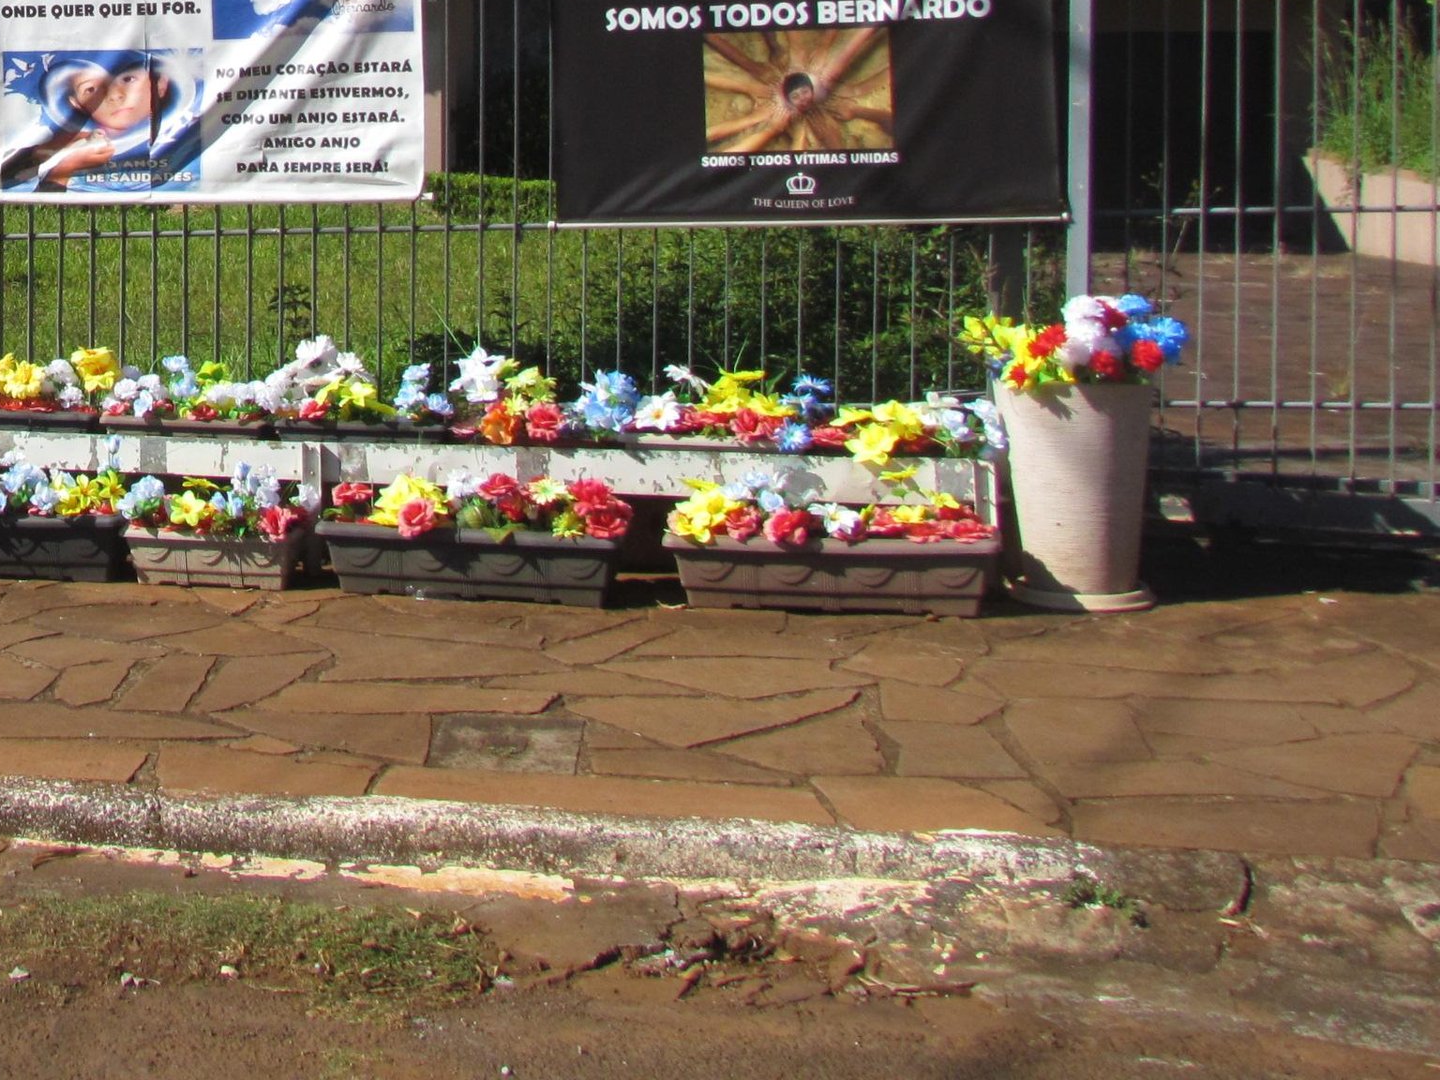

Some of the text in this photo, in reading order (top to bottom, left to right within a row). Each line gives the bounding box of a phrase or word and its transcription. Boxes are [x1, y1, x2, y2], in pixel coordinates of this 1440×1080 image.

[1, 2, 201, 19] ONDE QUER QUE EU FOR.
[605, 5, 701, 32] SOMOS
[708, 1, 808, 29] TODOS
[216, 59, 413, 79] NO MEU CORAÇÃO ESTARÁ
[216, 86, 410, 103] SE DISTANTE ESTIVERMOS,
[221, 109, 406, 125] COMO UM ANJO ESTARÁ.
[263, 136, 360, 149] AMIGO ANJO
[121, 158, 169, 169] ANOS
[236, 159, 389, 173] PARA SEMPRE SERÁ!
[701, 151, 899, 167] SOMOS TODOS VÍTIMAS UNIDAS
[86, 172, 192, 183] DE SAUDADES
[752, 196, 855, 209] THE QUEEN OF LOVE
